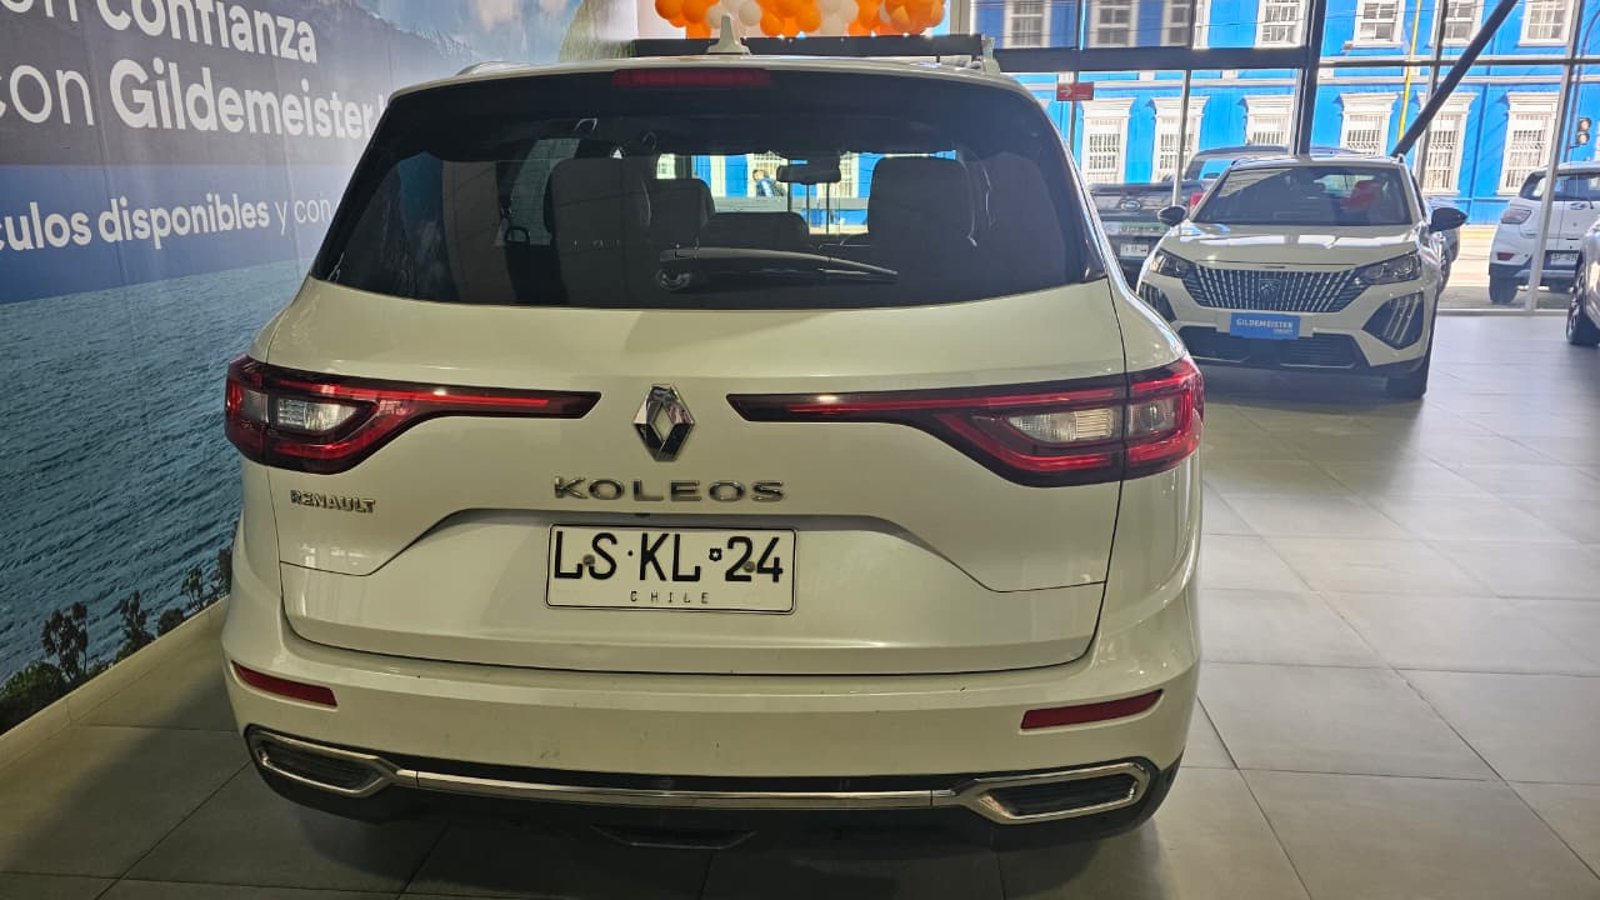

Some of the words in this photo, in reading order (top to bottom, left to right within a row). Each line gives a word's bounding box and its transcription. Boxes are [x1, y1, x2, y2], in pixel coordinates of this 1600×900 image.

[0, 65, 94, 126] on
[0, 202, 92, 250] ulos
[98, 193, 270, 250] disponibles
[274, 201, 288, 236] y
[294, 199, 332, 223] con
[290, 489, 376, 513] RENAULT
[554, 476, 785, 502] KOLEOS
[630, 591, 709, 604] CHILE
